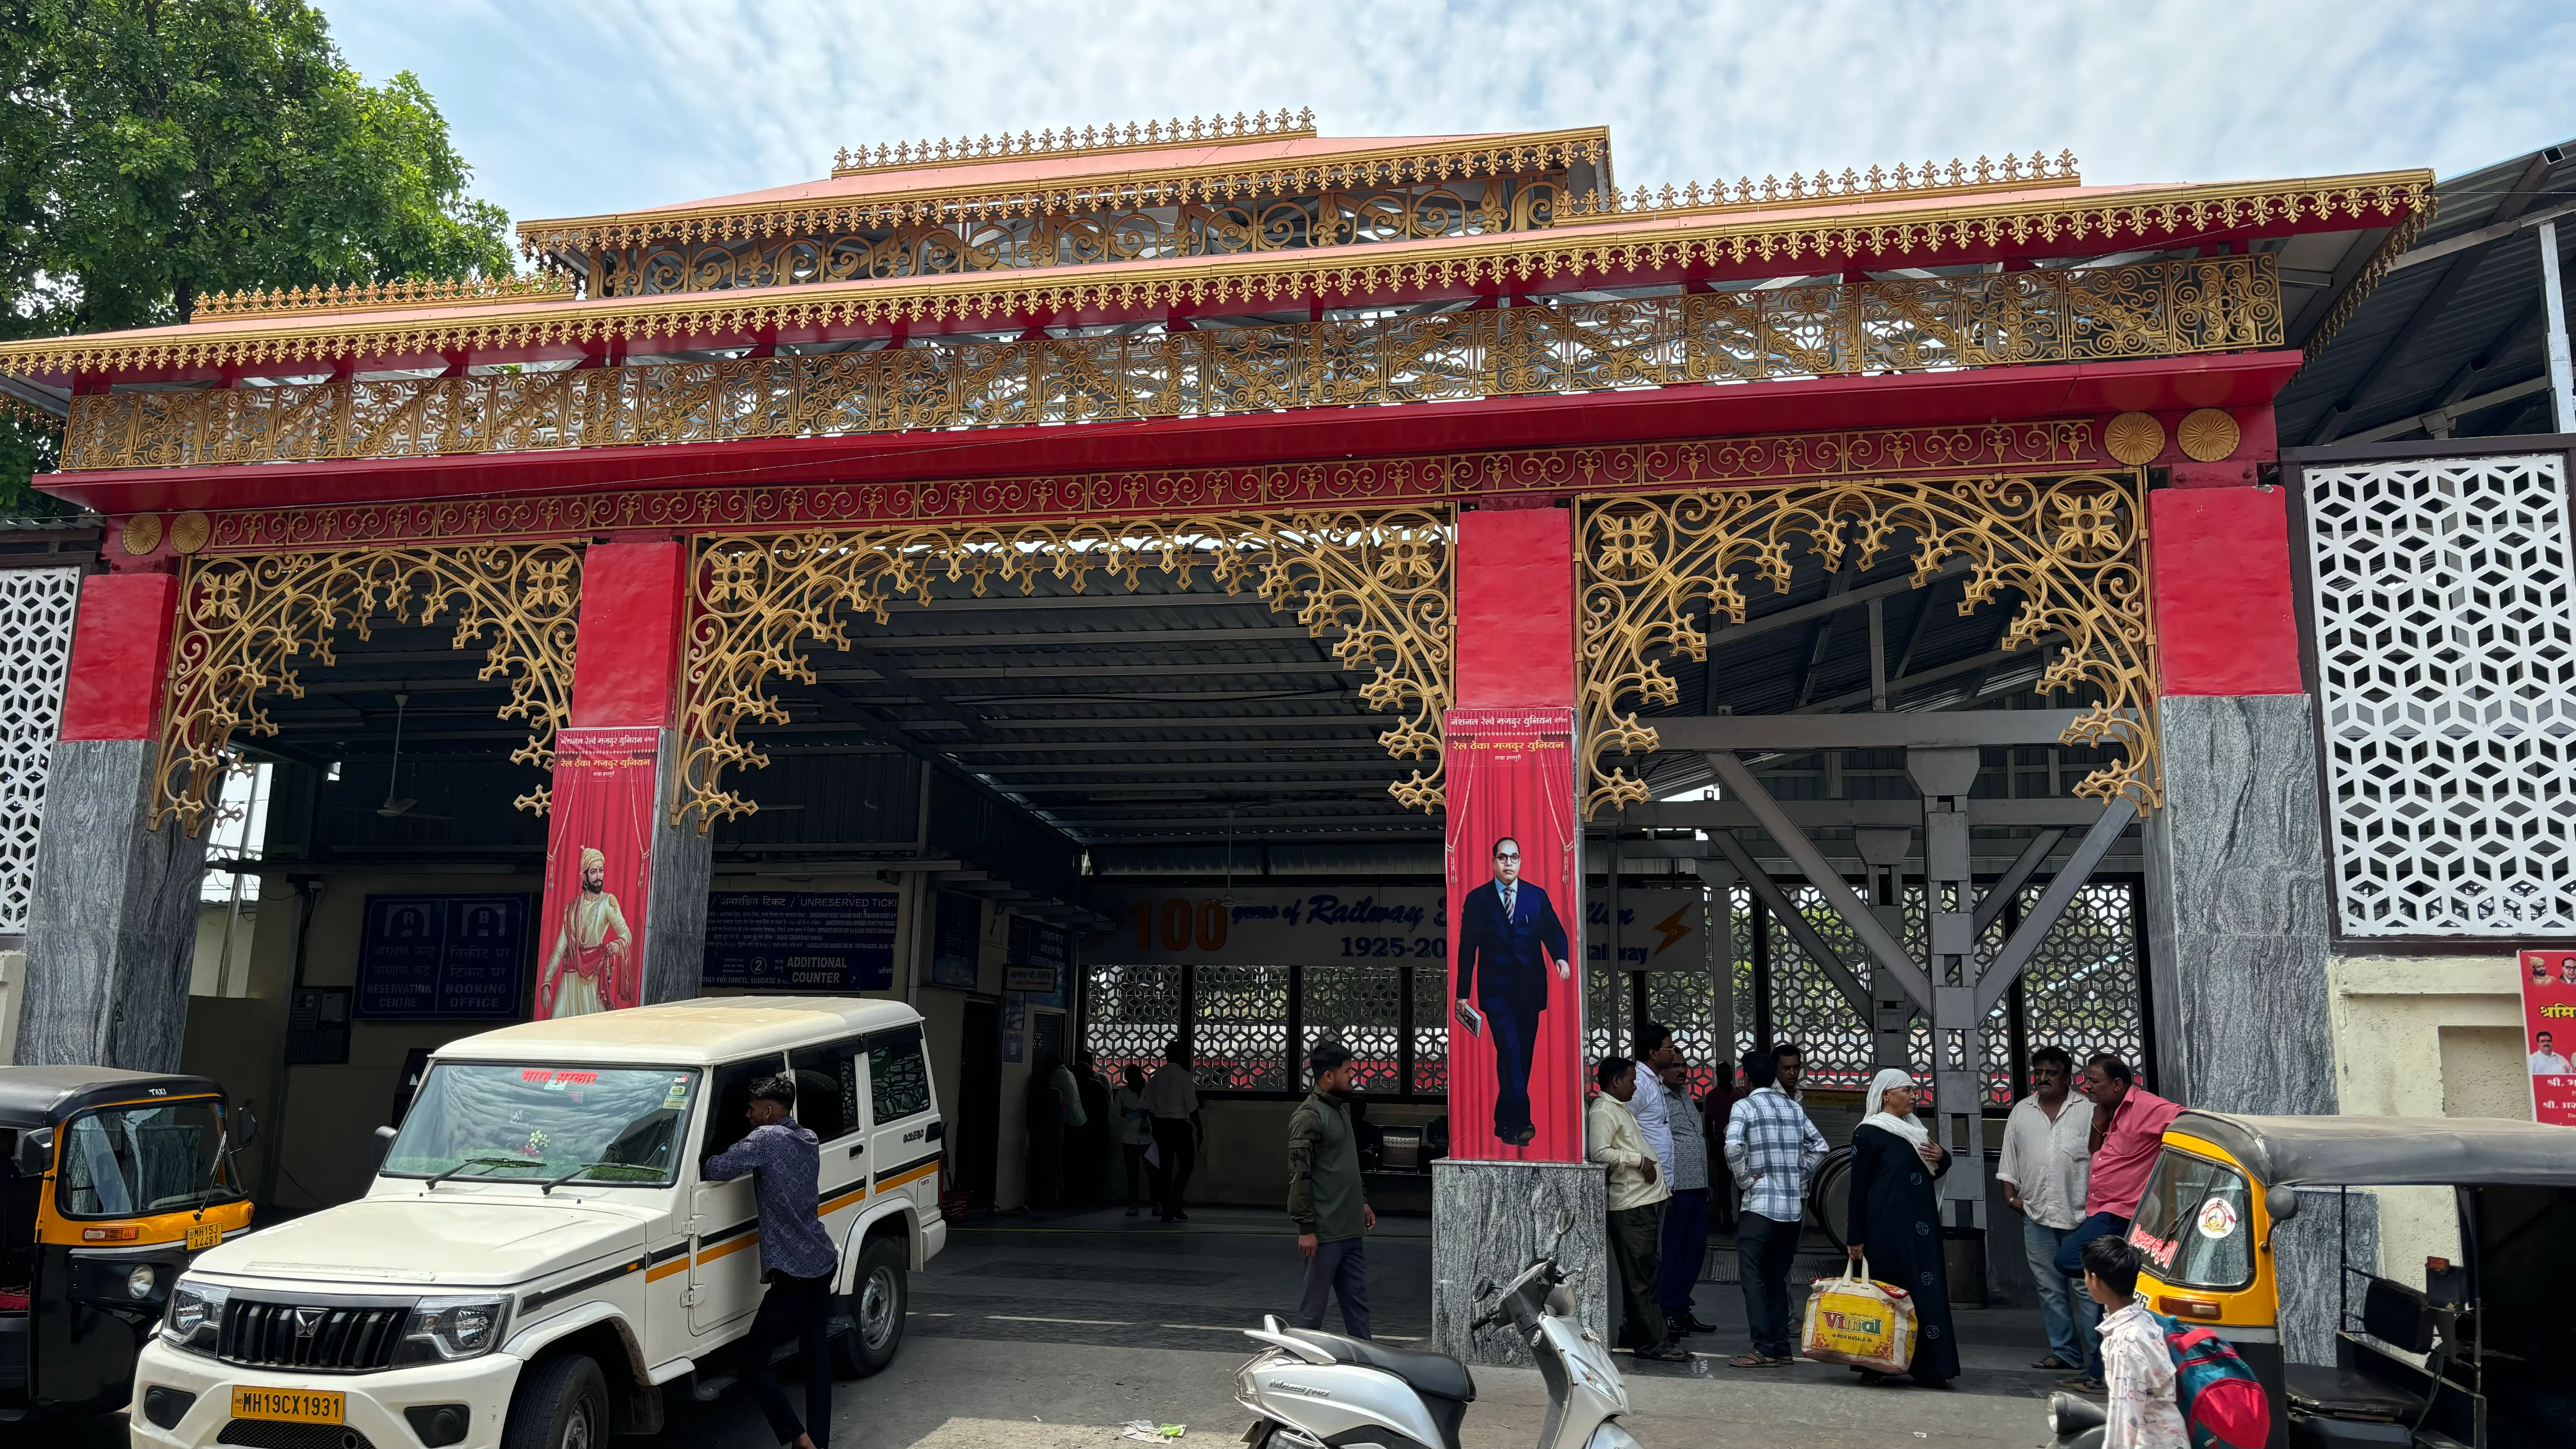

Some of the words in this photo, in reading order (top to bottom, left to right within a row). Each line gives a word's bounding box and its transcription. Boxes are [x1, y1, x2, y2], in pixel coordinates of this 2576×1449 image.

[1451, 717, 1478, 726] नॅशनल
[1481, 716, 1495, 725] रेल्वे
[1497, 718, 1521, 727] मजदुर
[1523, 715, 1552, 727] युनियन
[584, 736, 596, 745] रेल्वे
[598, 737, 617, 747] मजदुर
[619, 735, 642, 746] युनियन
[1452, 741, 1467, 750] रेल
[1470, 740, 1490, 750] ठेका
[1493, 742, 1525, 752] मजदुर
[1527, 739, 1564, 752] युनियन
[560, 758, 572, 767] रेल
[575, 758, 591, 767] ठेका
[593, 759, 618, 769] मजदुर
[621, 757, 651, 768] युनियन
[720, 895, 759, 906] अनारक्षित
[762, 896, 786, 906] टिकट
[800, 898, 869, 906] UNRESERVED
[1129, 898, 1227, 951] 100
[1282, 899, 1302, 926] of
[1306, 895, 1424, 932] Railway
[372, 946, 409, 957] आरक्षण
[449, 944, 489, 959] तिकीट
[495, 948, 511, 958] घर
[1341, 937, 1447, 958] 1925-20
[754, 960, 762, 971] 2
[787, 957, 847, 968] ADDITIONAL
[371, 964, 409, 976] आरक्षण
[449, 964, 485, 978] टिकट
[490, 967, 506, 978] घर
[791, 971, 840, 984] COUNTER
[367, 984, 432, 994] RESERVATION
[445, 984, 506, 994] BOOKING
[379, 998, 417, 1007] CENTRE
[450, 998, 499, 1007] OFFICE
[2539, 1002, 2576, 1019] श्रमि
[521, 1069, 553, 1083] भारत
[556, 1071, 599, 1086] सरकार
[148, 1088, 167, 1096] TAXI
[194, 1224, 218, 1237] MH15J
[195, 1235, 217, 1247] A4481
[1822, 1310, 1882, 1336] Vimal
[243, 1393, 339, 1417] MH19CX1931
